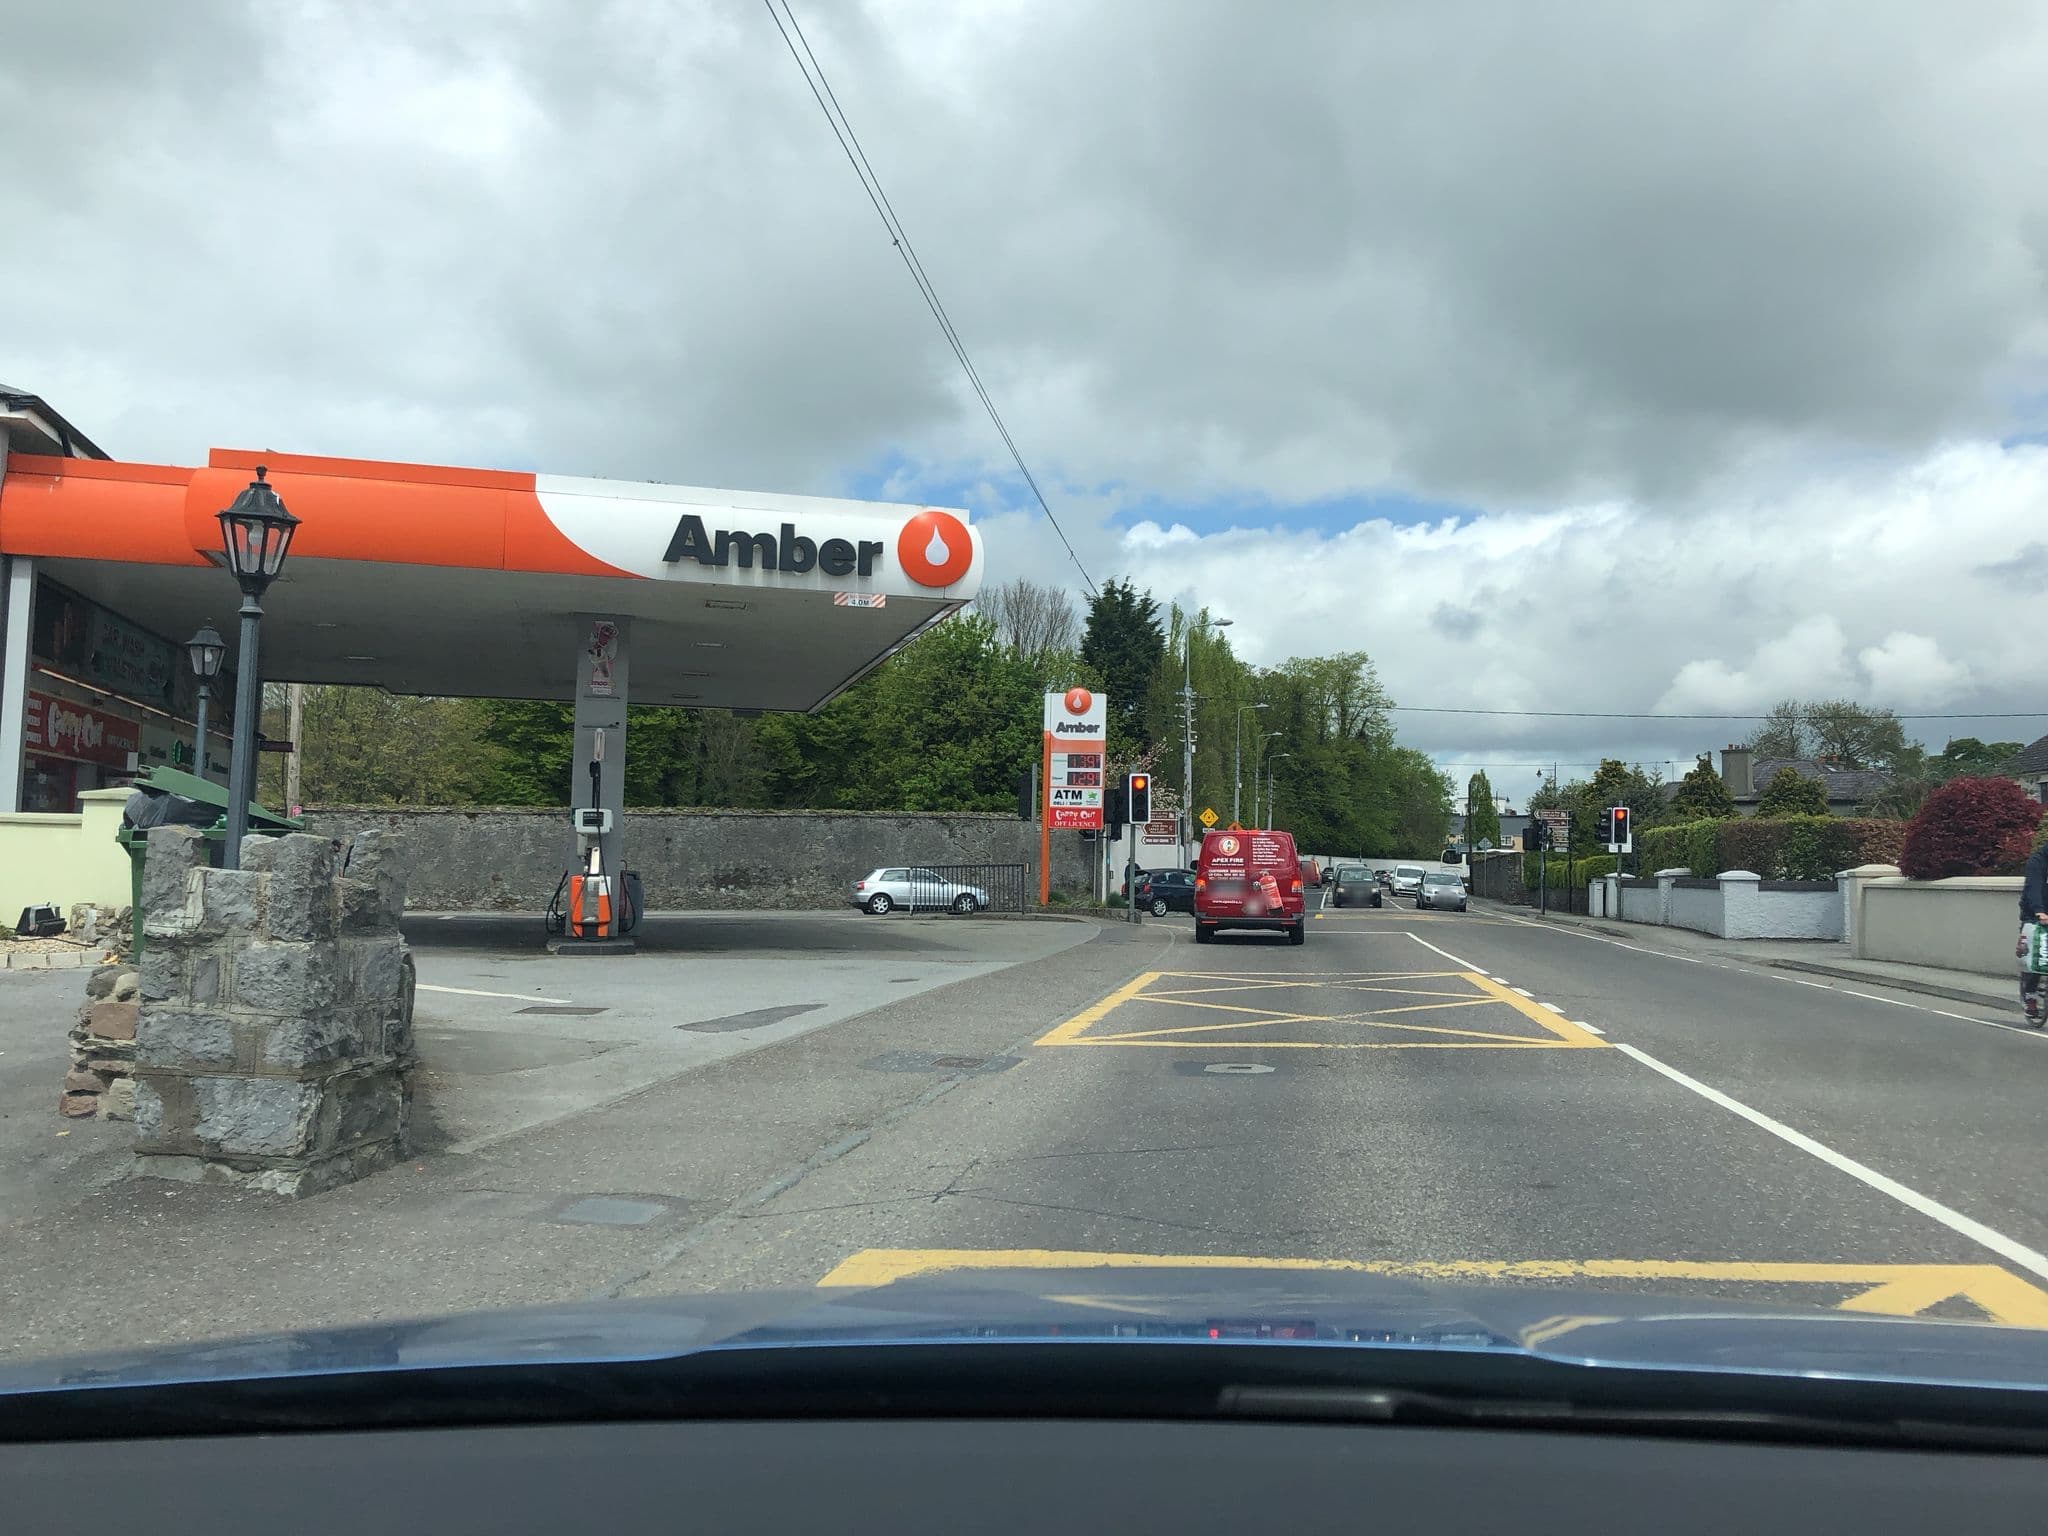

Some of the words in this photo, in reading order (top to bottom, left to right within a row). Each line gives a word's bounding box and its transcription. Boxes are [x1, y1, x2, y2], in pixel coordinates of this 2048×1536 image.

[662, 514, 883, 577] Amber
[1055, 721, 1100, 733] Amber
[1054, 790, 1082, 800] ATM
